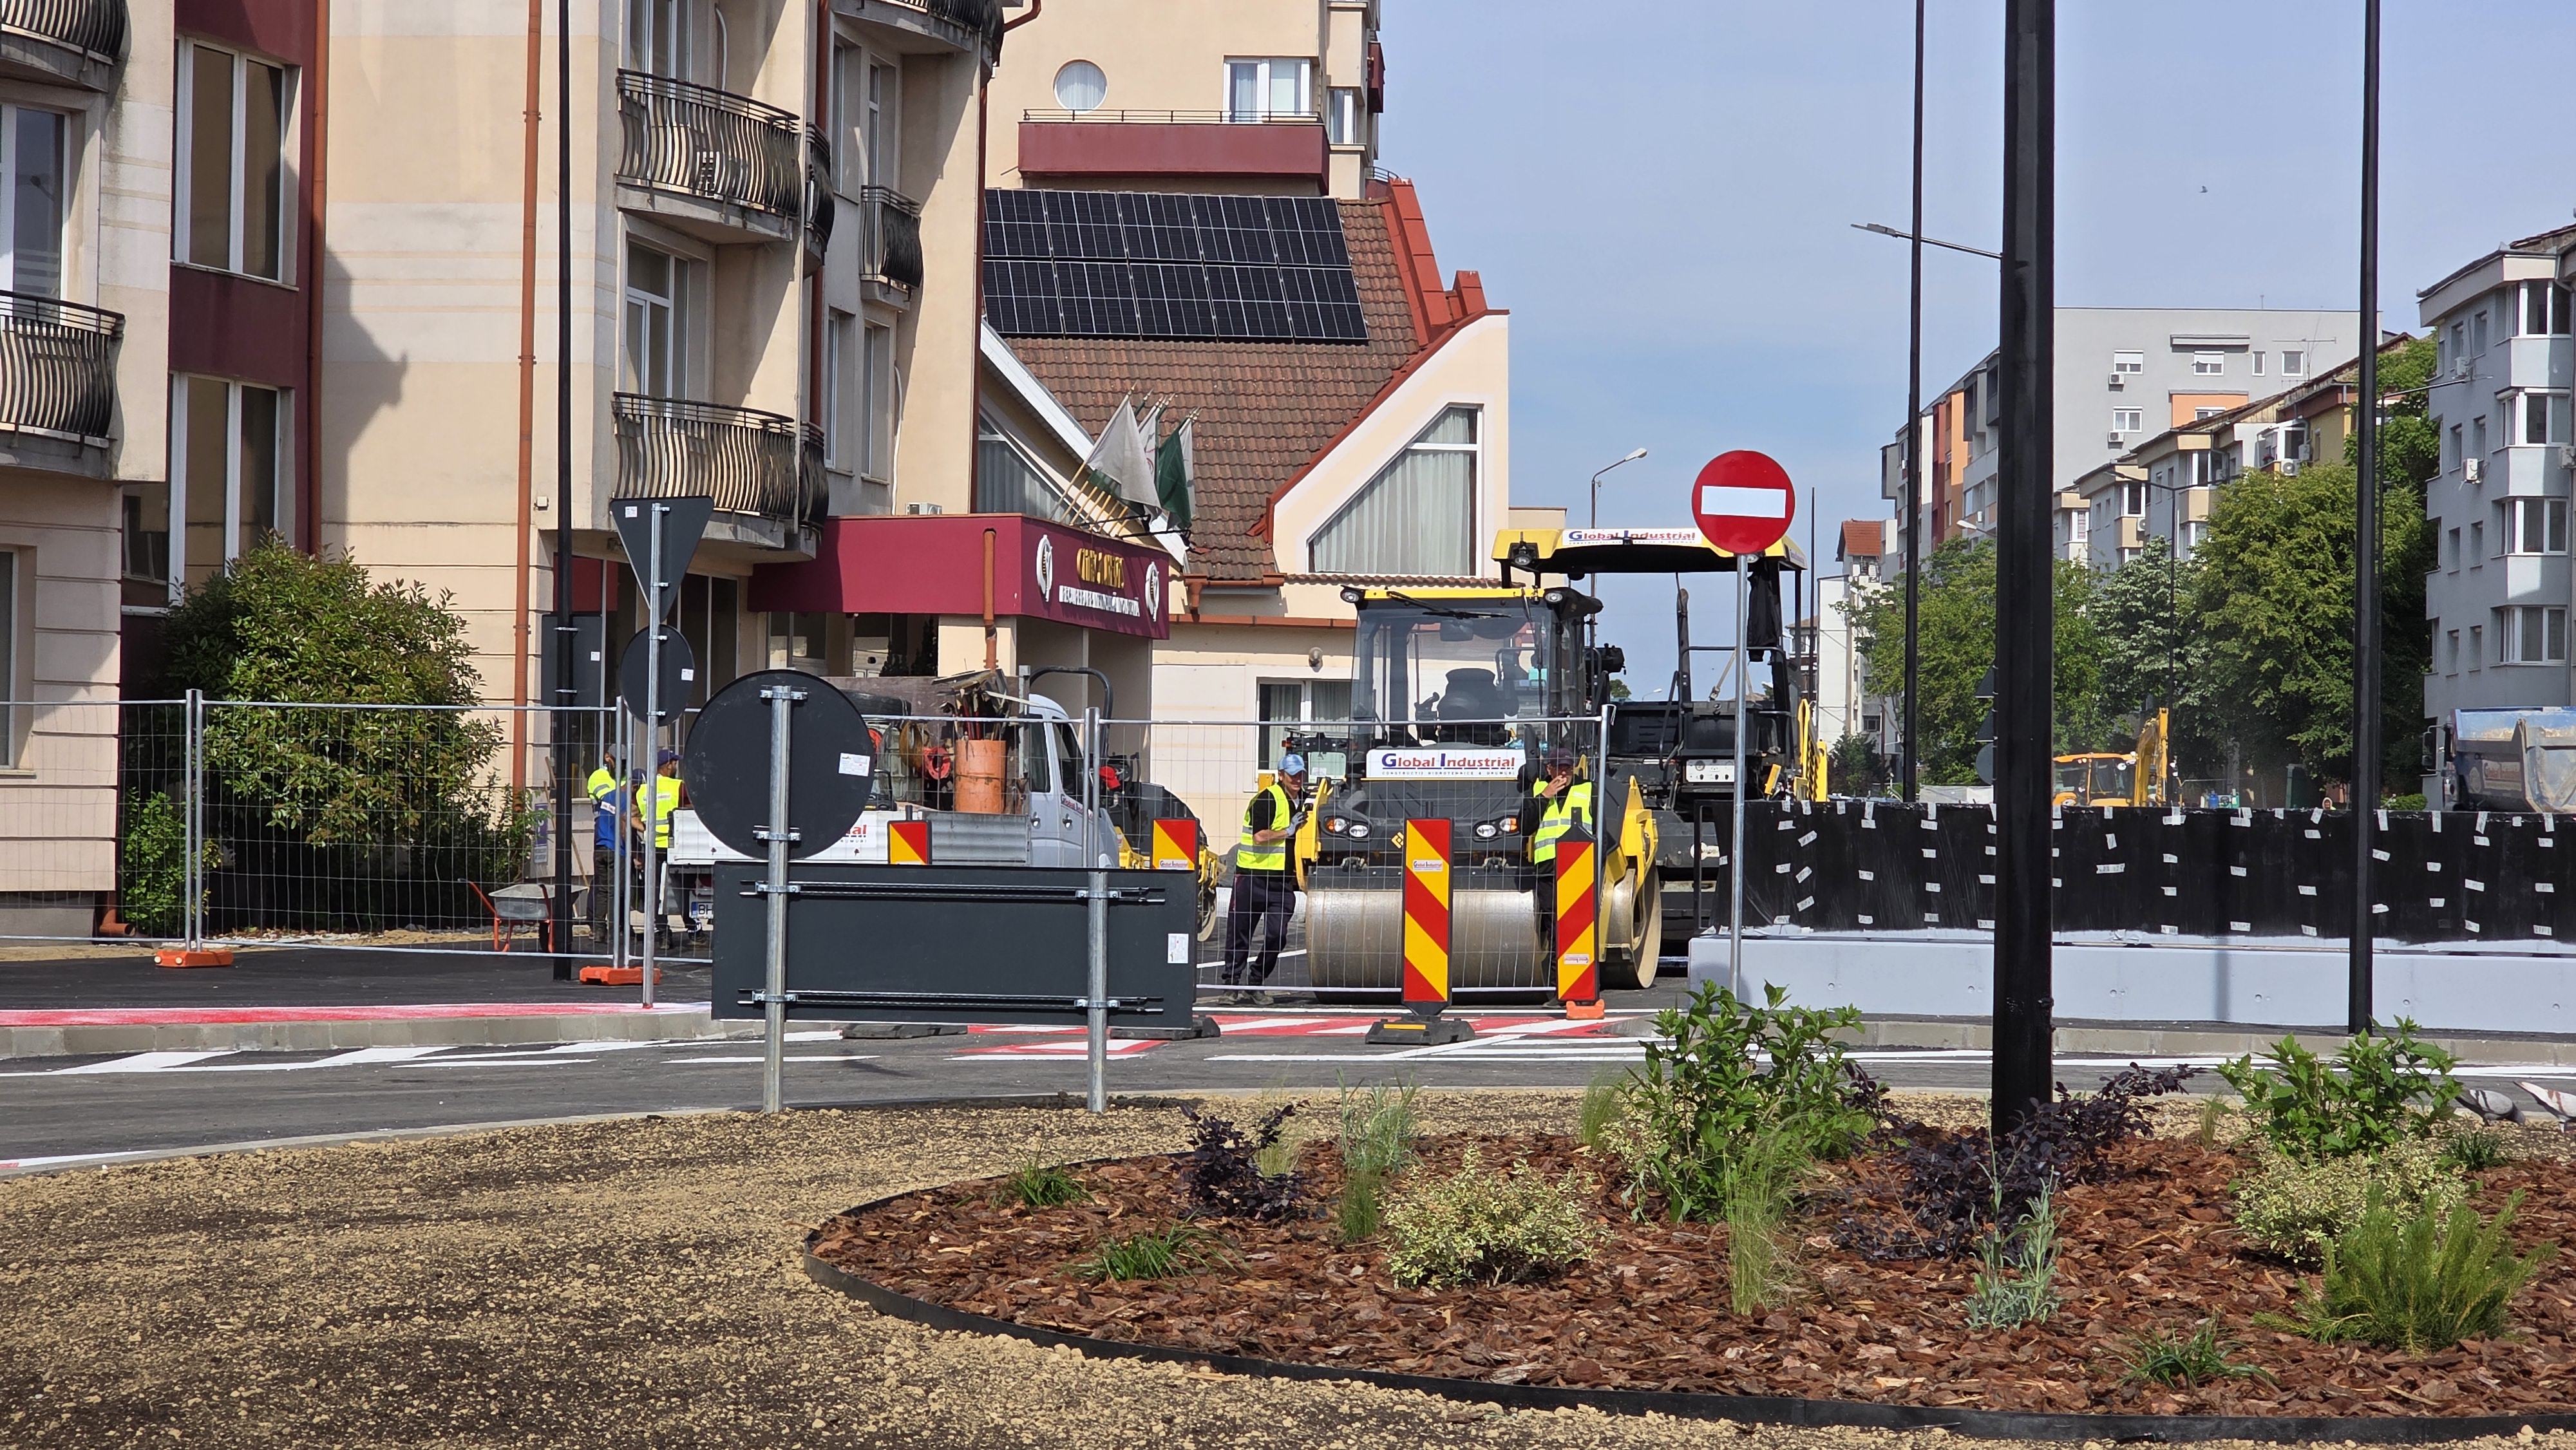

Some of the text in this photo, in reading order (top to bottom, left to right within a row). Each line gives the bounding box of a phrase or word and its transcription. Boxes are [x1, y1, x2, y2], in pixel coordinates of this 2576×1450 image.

[1568, 530, 1695, 540] Global Industrial
[1381, 753, 1515, 767] Global Industrial
